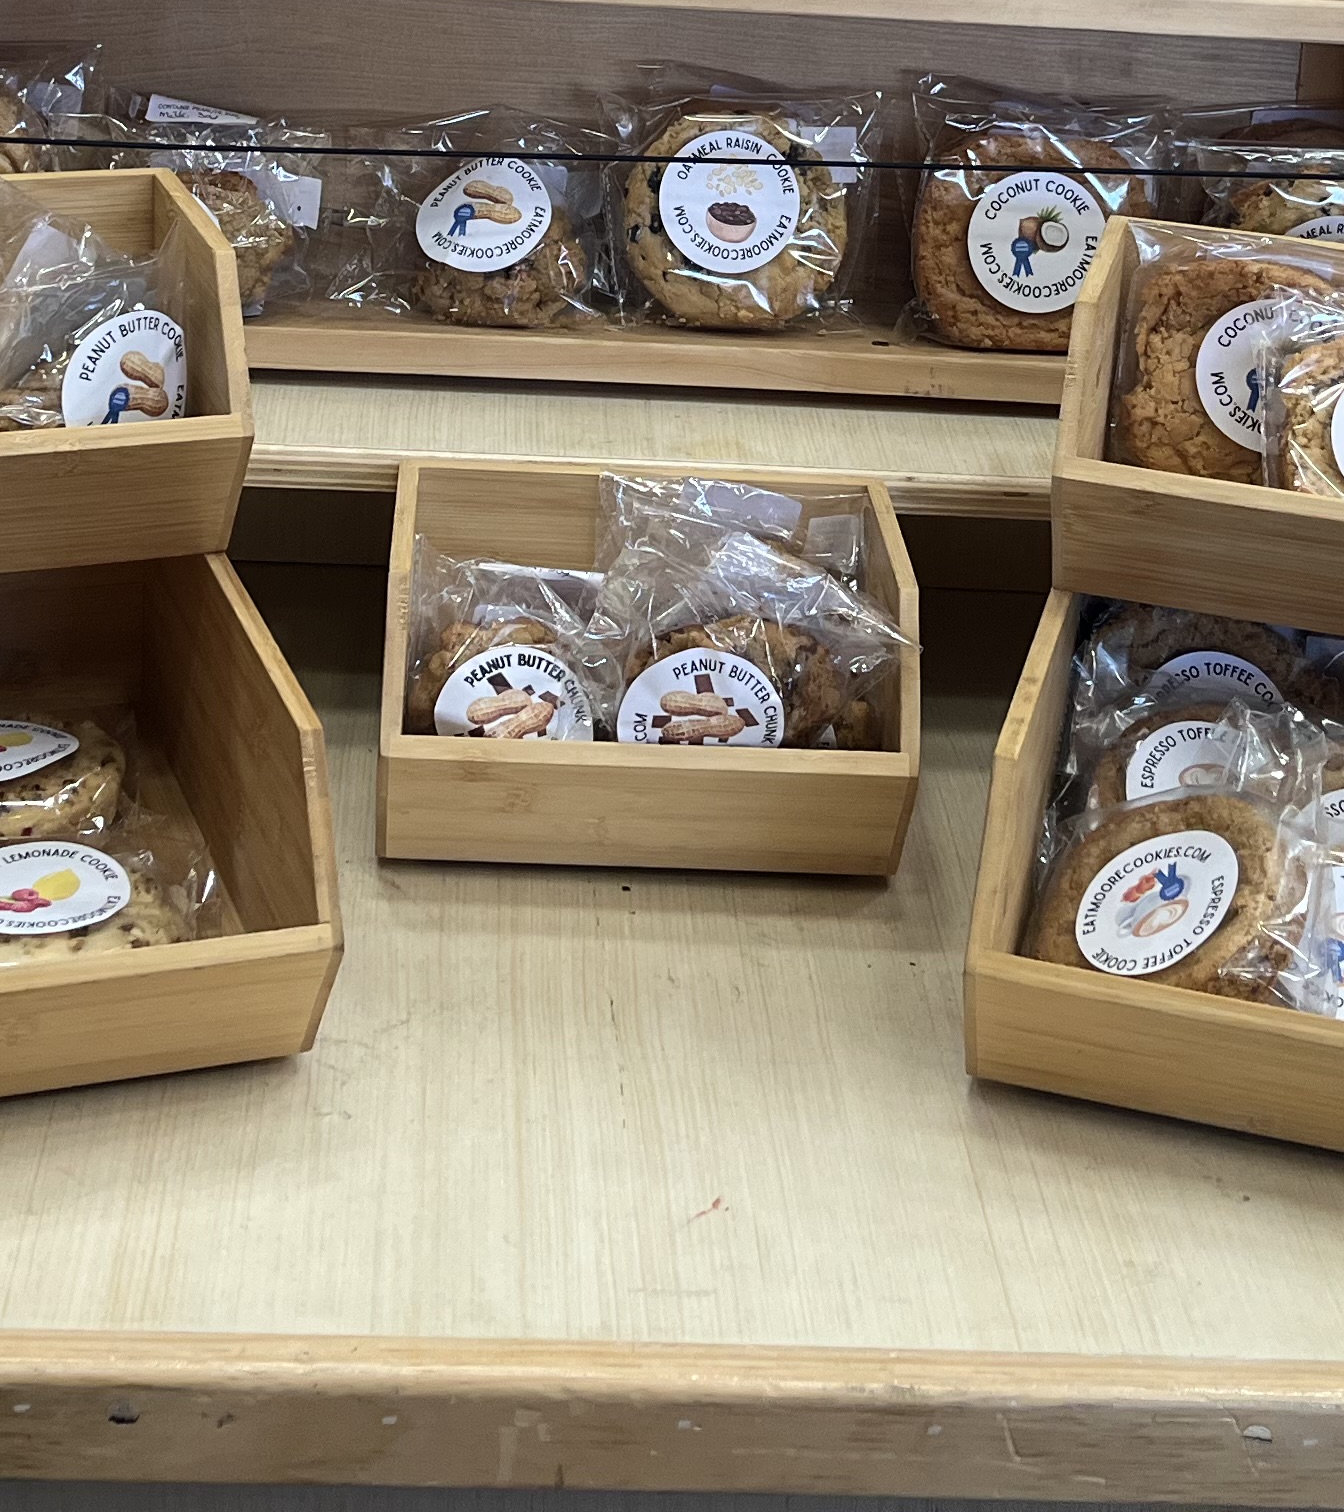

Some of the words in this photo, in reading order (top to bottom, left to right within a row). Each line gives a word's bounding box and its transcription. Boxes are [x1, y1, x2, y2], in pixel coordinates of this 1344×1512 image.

[726, 137, 763, 156] RAISIN
[507, 160, 543, 193] COOKIE
[983, 178, 1041, 221] COCONUT
[1044, 180, 1091, 217] COOKIE
[432, 205, 547, 260] EATMOORECOOKIES.COM
[673, 204, 791, 261] EATMOORECOOKIES.COM
[79, 331, 117, 382] PEANUT
[118, 315, 161, 335] BUTTER
[463, 652, 513, 688] PEANUT
[517, 653, 566, 683] BUTTER
[672, 659, 725, 681] PEANUT
[729, 663, 770, 707] BUTTER
[762, 705, 776, 746] CHUNK
[1141, 735, 1177, 790] ESPRESSO
[1, 848, 78, 869] LEMONADE
[80, 853, 119, 883] COOKIE
[1081, 846, 1212, 936] EATMOORECOOKIES.COM
[1192, 875, 1224, 937] ESPRESSO
[1091, 948, 1137, 971] COOKIE
[1142, 937, 1192, 970] TOFFEE
